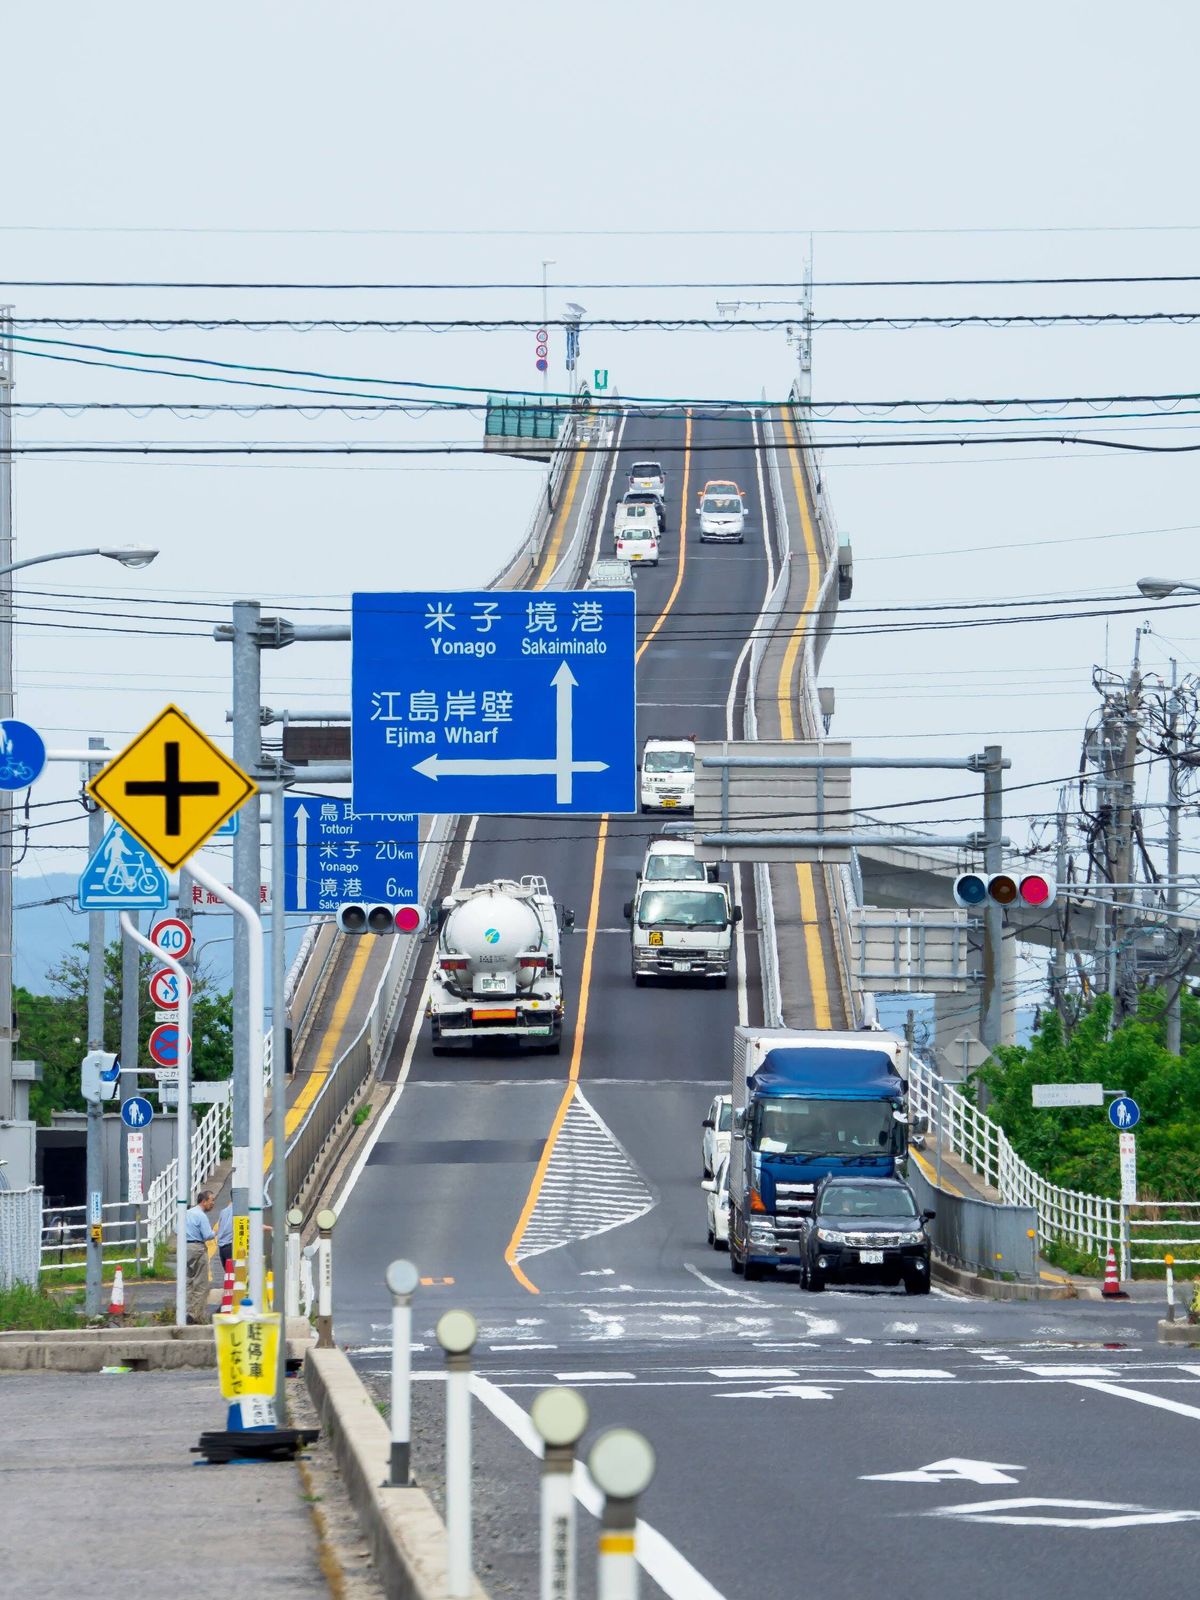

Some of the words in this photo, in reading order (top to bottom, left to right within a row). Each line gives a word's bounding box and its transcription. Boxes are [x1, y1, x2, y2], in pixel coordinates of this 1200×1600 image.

[424, 601, 501, 633] 米子
[525, 600, 604, 633] 境港
[430, 637, 497, 658] Yonago
[521, 637, 607, 655] Sakaiminato
[370, 689, 514, 723] 江島岸壁
[385, 726, 436, 748] Ejima
[444, 727, 499, 745] Wharf
[319, 802, 361, 822] 鳥取
[319, 823, 354, 835] Tottori
[319, 840, 362, 859] 米子
[319, 861, 359, 873] Yonago
[318, 878, 362, 897] 境港
[160, 930, 183, 949] 40
[247, 1322, 264, 1380] 駐停車
[230, 1332, 243, 1395] しないで
